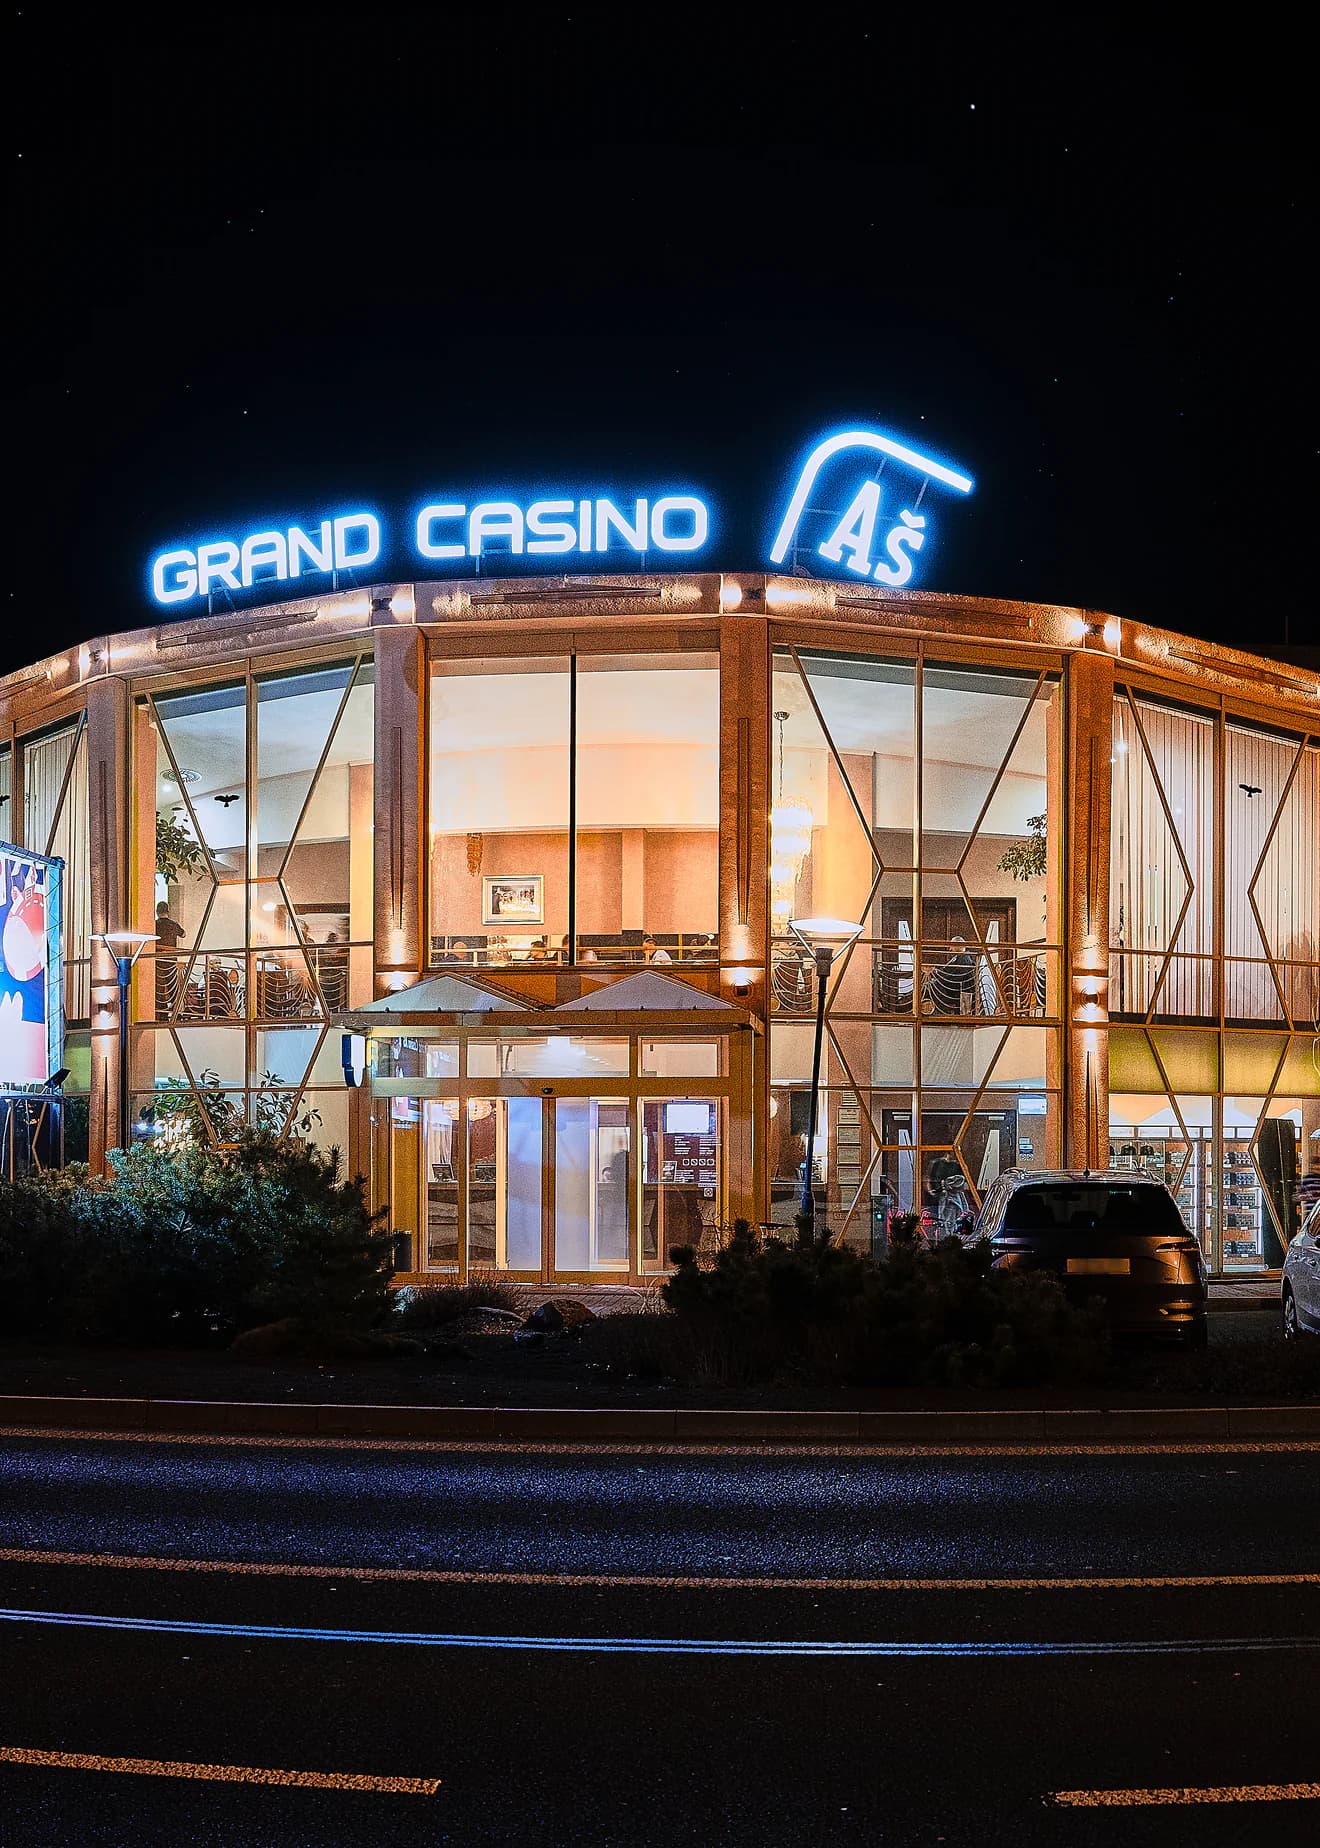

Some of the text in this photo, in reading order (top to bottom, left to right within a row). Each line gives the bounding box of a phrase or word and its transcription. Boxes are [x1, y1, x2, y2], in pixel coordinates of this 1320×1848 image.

[153, 496, 708, 603] GRAND CASINO
[818, 480, 926, 587] Aš
